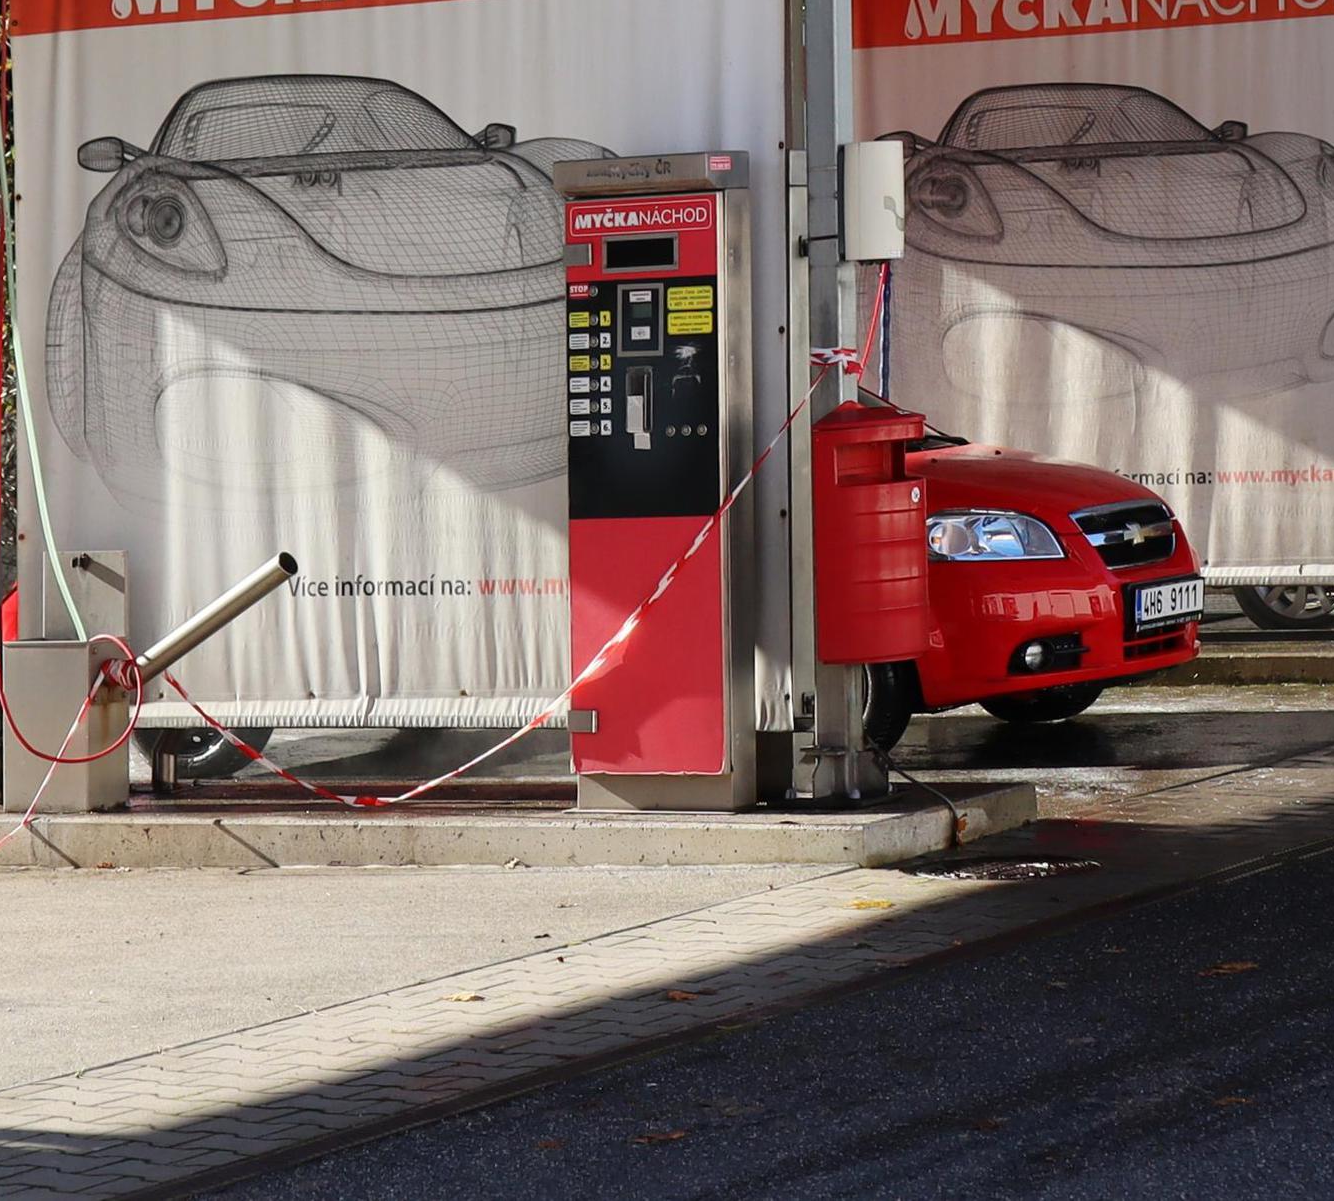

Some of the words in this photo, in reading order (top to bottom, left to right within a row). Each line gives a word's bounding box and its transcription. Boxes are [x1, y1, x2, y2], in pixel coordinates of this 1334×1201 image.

[574, 206, 707, 230] MYČKANÁCHOD
[569, 285, 589, 294] STOP
[1185, 471, 1212, 484] na:
[288, 576, 328, 597] Více
[335, 574, 434, 596] informací
[441, 578, 472, 596] na:
[1144, 590, 1163, 616] 4H6
[1170, 583, 1197, 611] 9111
